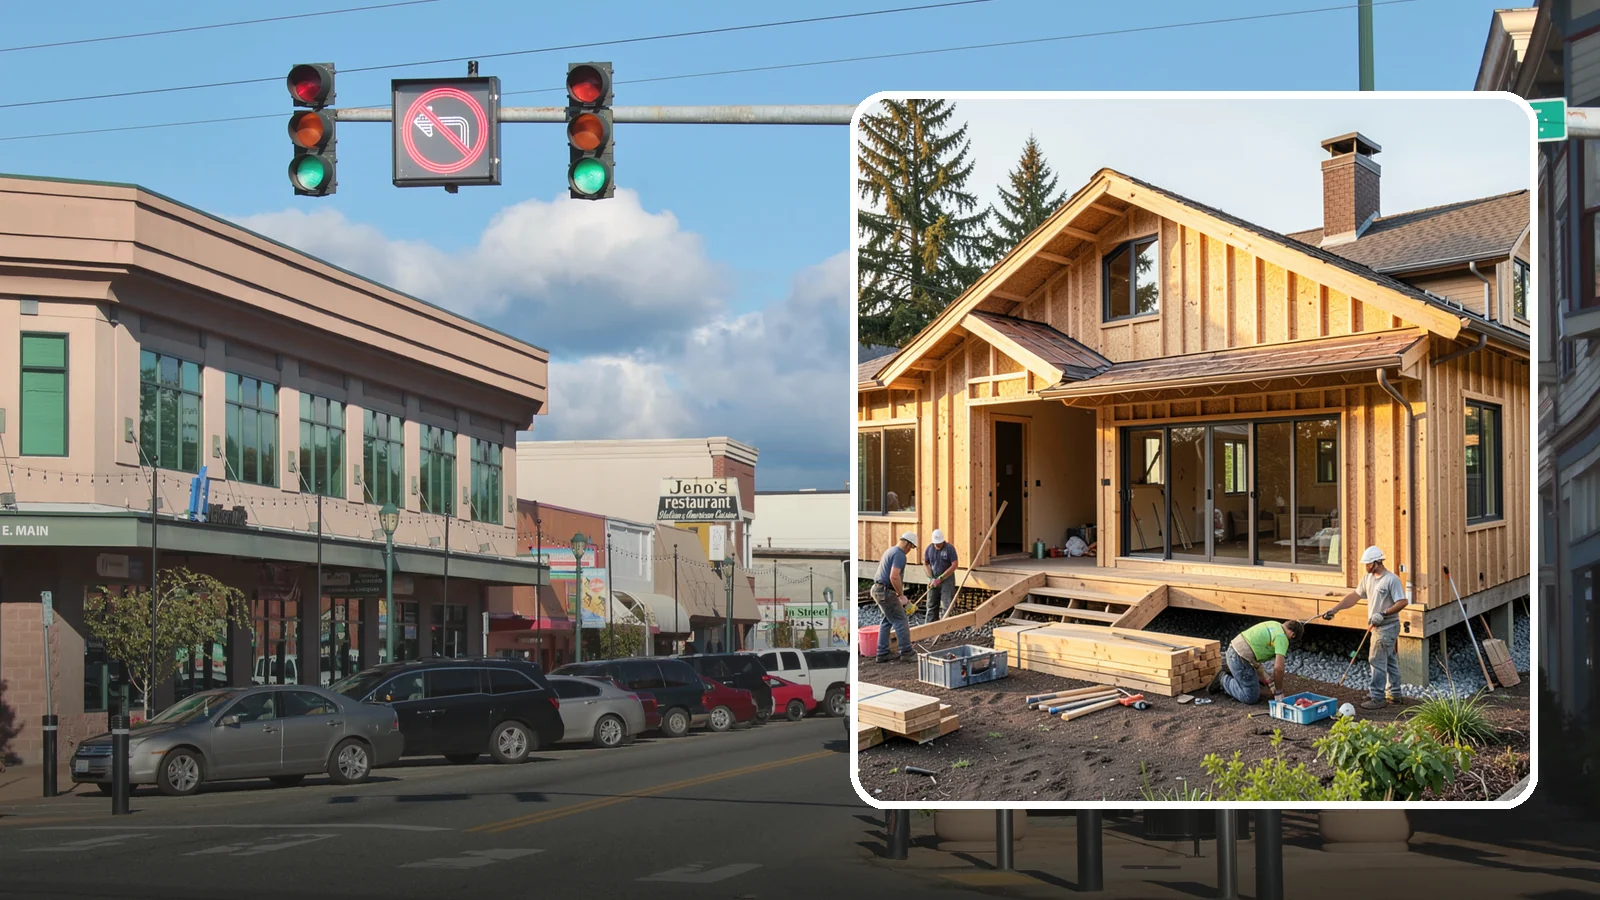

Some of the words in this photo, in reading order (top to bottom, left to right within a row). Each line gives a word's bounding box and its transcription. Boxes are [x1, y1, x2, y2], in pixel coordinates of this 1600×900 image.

[669, 480, 728, 494] Jeno's
[665, 496, 731, 509] restaurant
[686, 509, 714, 519] American
[714, 509, 737, 519] Cuisine
[2, 525, 13, 536] E.
[15, 525, 49, 536] MAIN
[797, 607, 828, 617] Street
